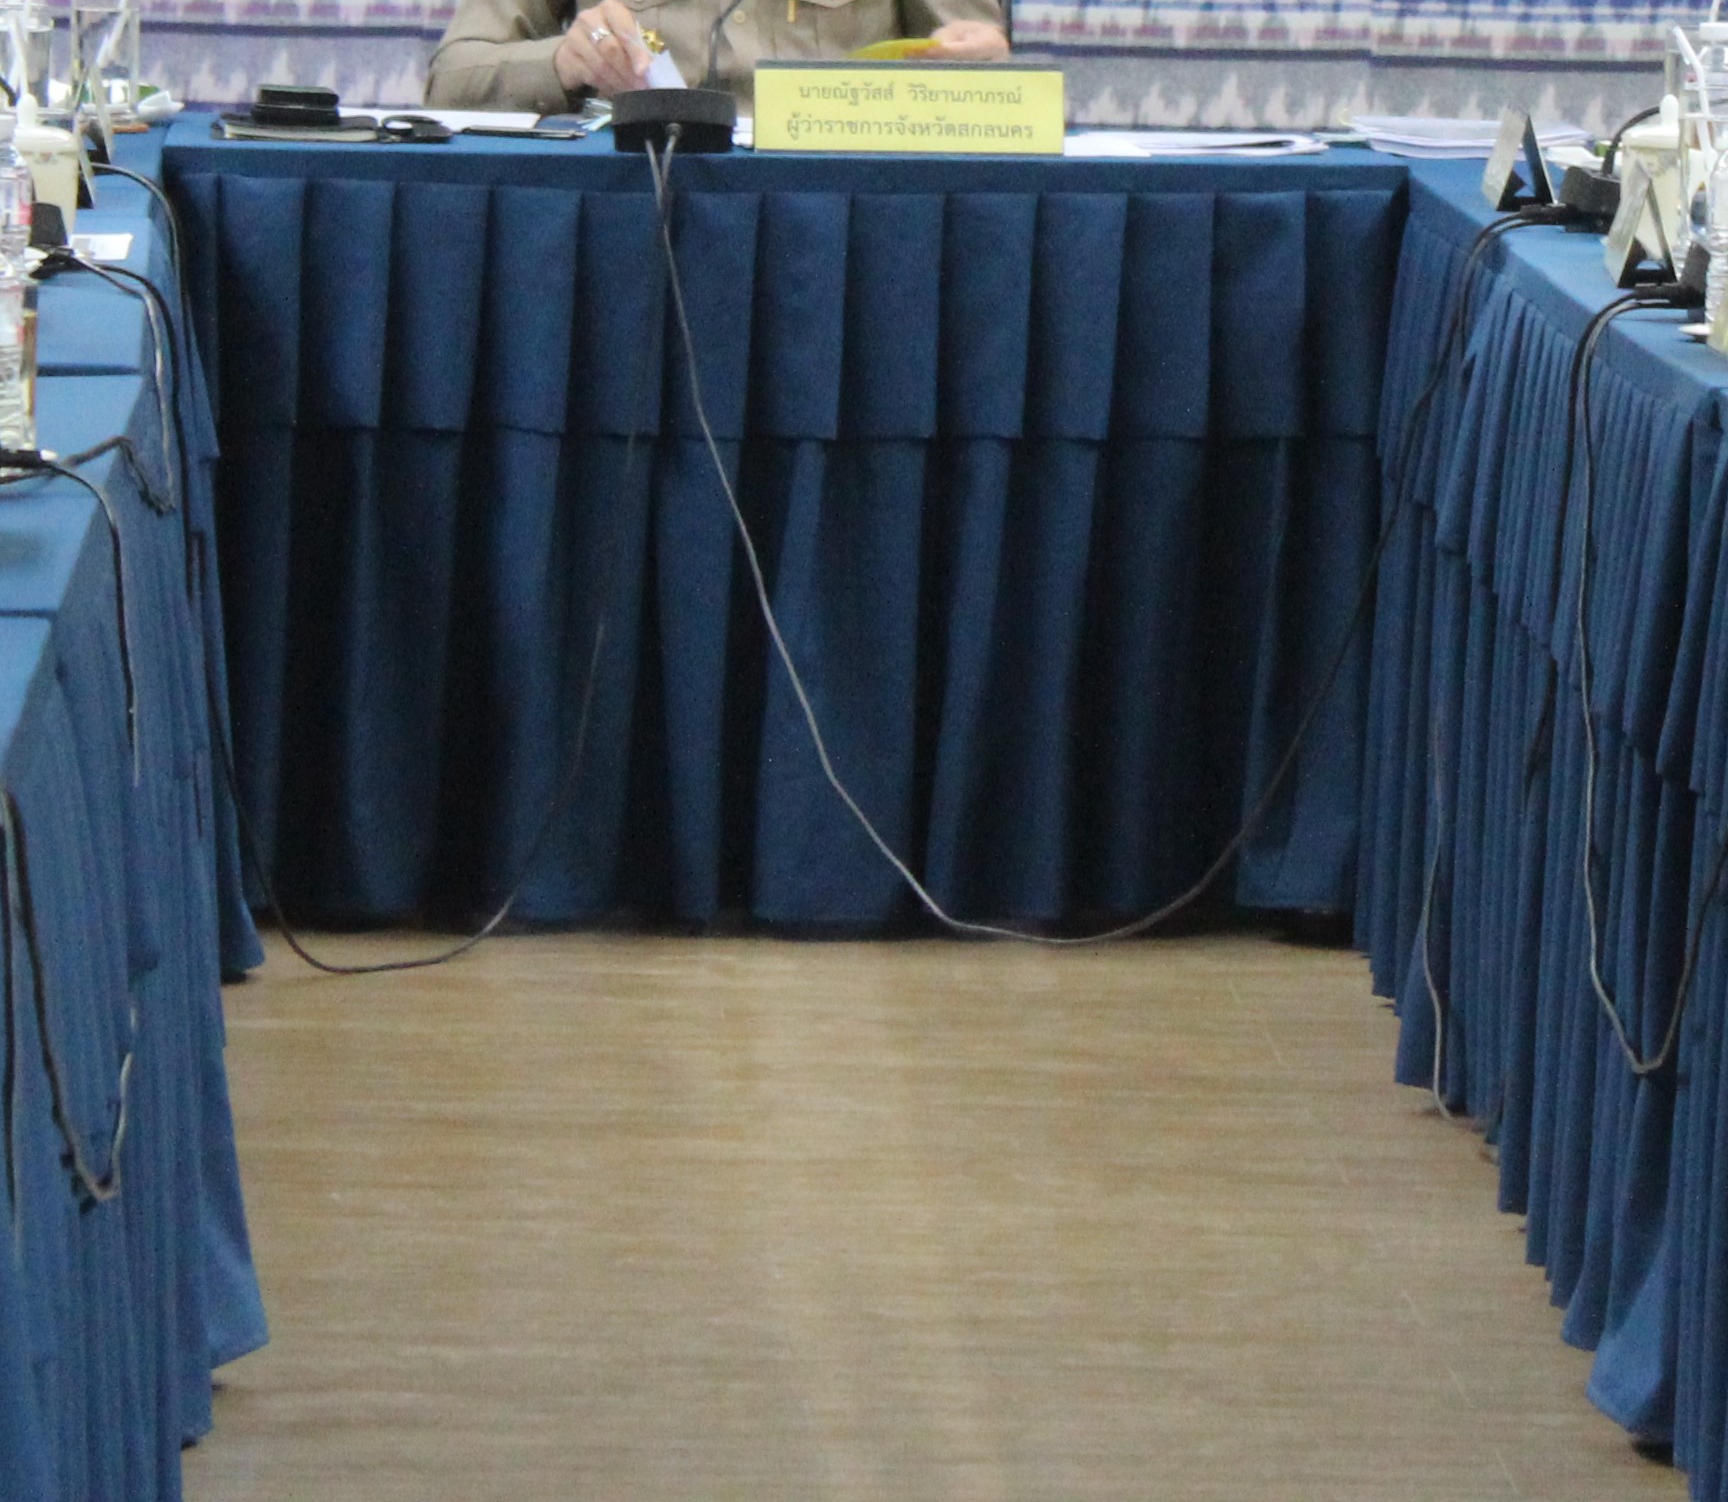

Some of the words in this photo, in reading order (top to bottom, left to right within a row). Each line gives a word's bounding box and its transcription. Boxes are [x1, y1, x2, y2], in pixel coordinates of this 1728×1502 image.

[786, 111, 1034, 140] ผู้ว่าราชการจังหวัดสกลนคร
